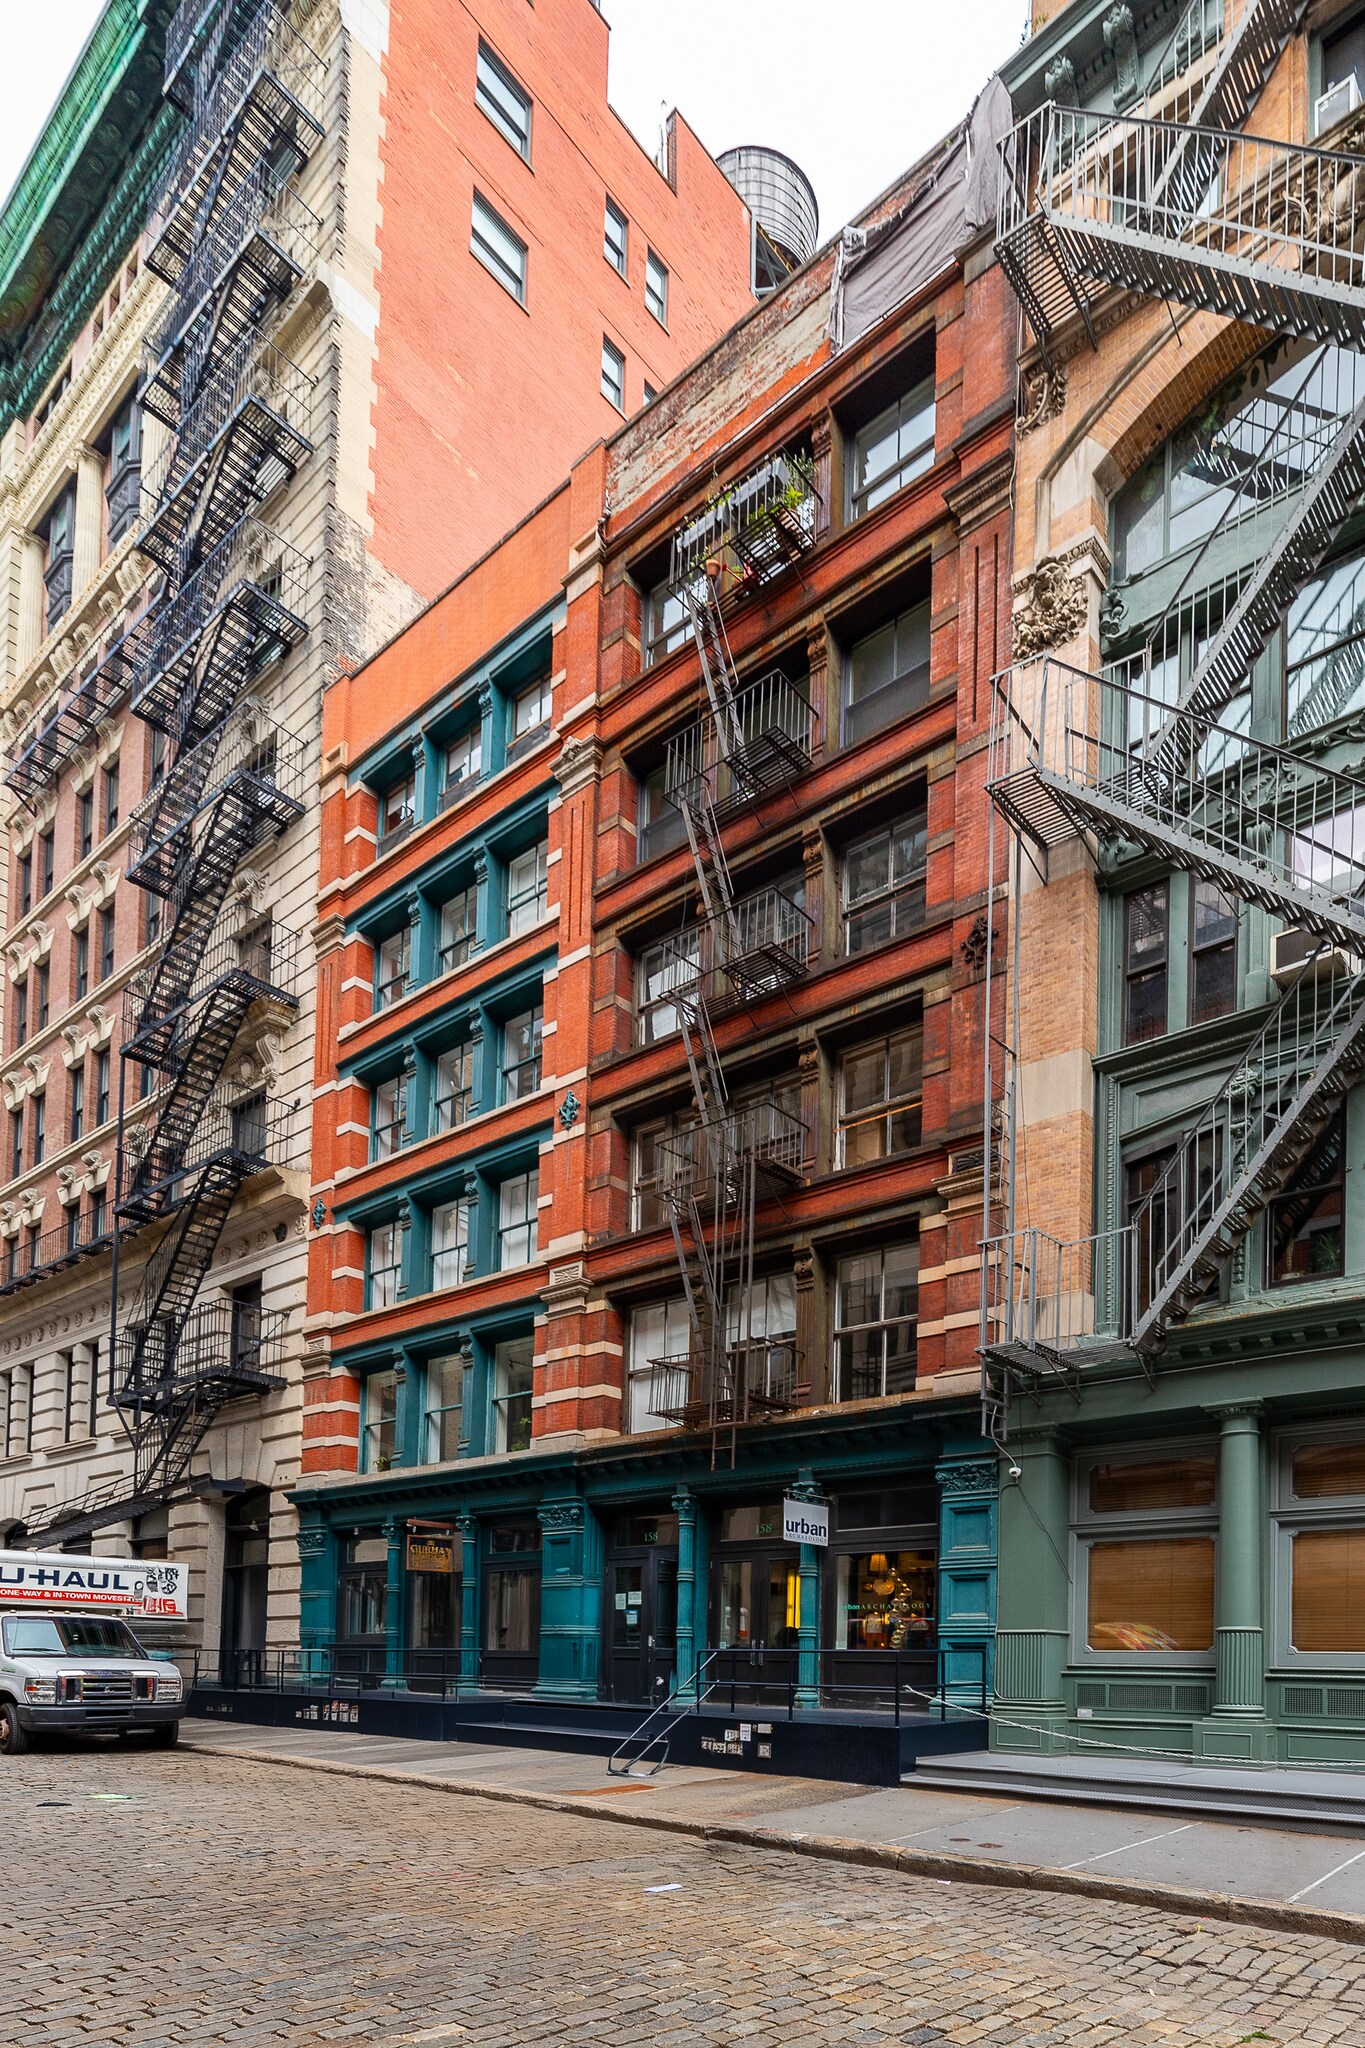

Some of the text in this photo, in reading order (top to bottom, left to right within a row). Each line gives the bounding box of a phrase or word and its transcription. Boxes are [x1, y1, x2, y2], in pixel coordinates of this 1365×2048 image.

[756, 1523, 772, 1534] 158
[785, 1518, 827, 1537] urban
[645, 1532, 658, 1541] 158
[785, 1533, 827, 1543] ARCHAEOLOGY
[0, 1566, 129, 1590] U-HAUL
[0, 1588, 42, 1597] ONE-WAY
[53, 1592, 91, 1600] IN-TOWN
[93, 1594, 123, 1602] MOVES
